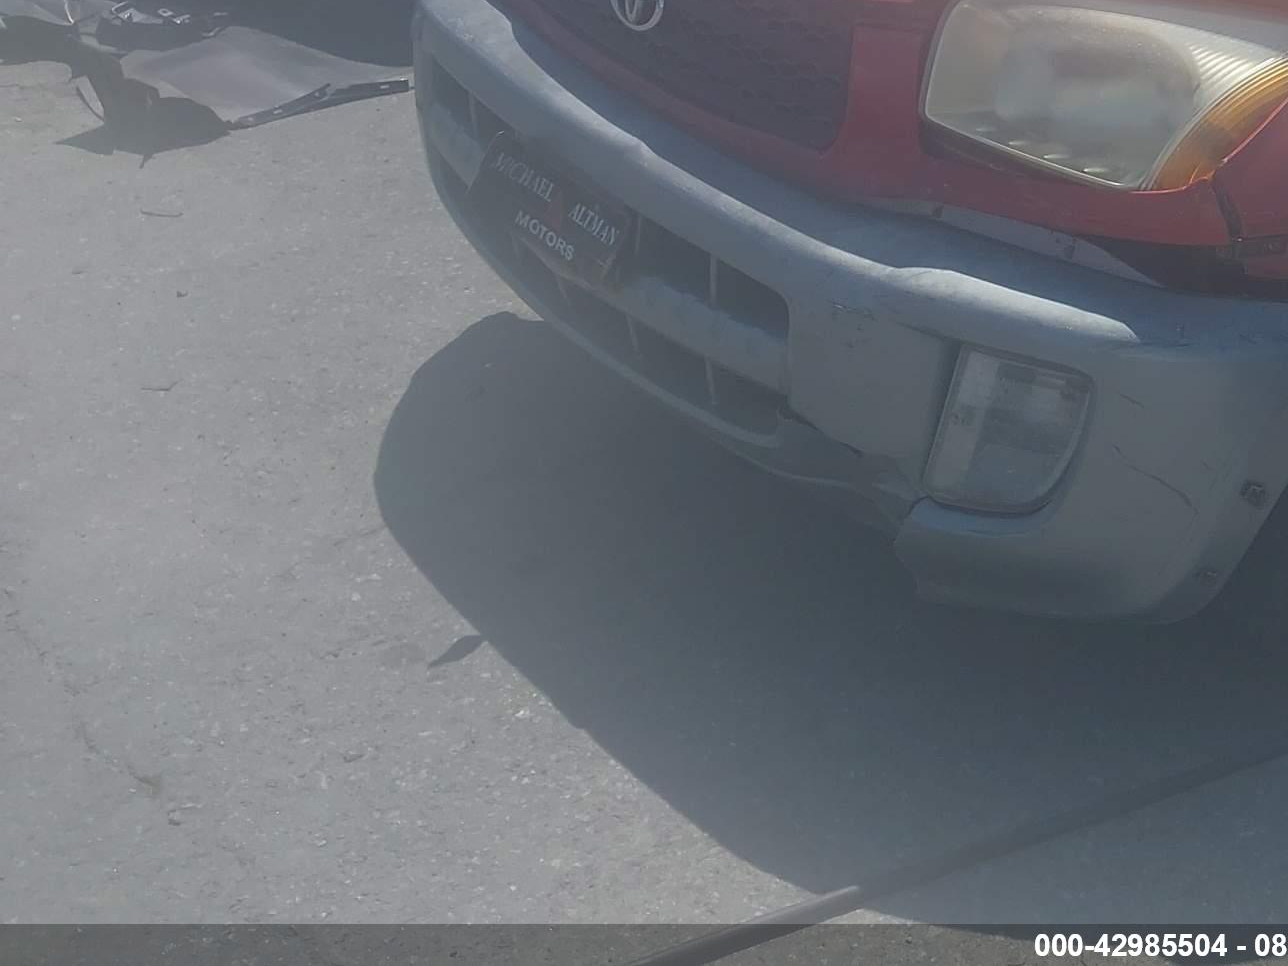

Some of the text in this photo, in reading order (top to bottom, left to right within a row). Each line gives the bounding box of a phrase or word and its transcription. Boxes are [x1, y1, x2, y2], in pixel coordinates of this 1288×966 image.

[491, 152, 619, 246] MICHAEL ALTMAN
[514, 210, 576, 261] MOTORS
